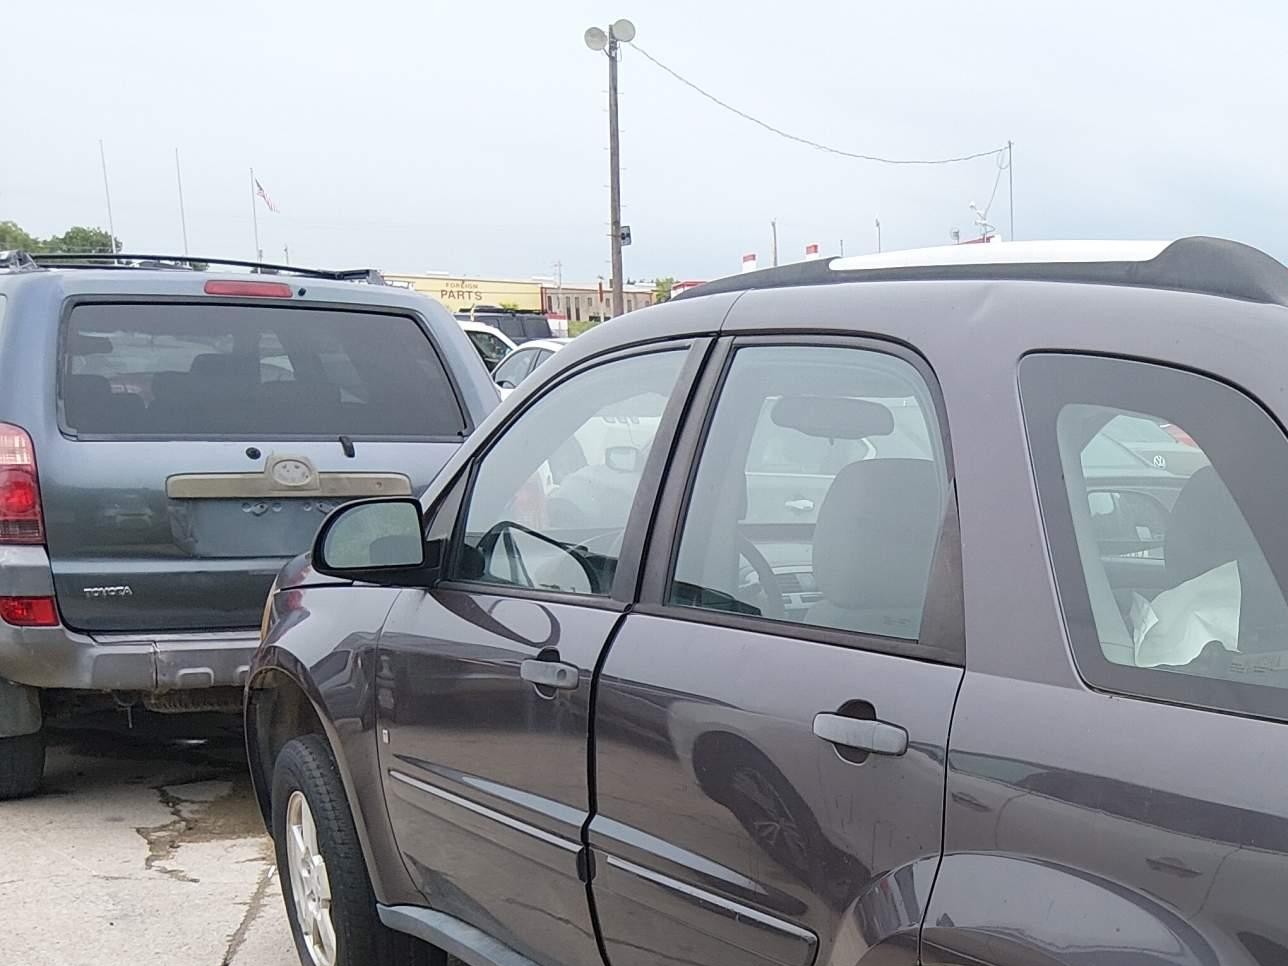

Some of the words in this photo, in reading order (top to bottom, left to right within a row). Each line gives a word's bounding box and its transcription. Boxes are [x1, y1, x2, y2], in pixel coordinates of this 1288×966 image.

[445, 281, 480, 289] FOREIGN
[440, 289, 483, 301] PARTS
[83, 586, 133, 599] TOYOTA
